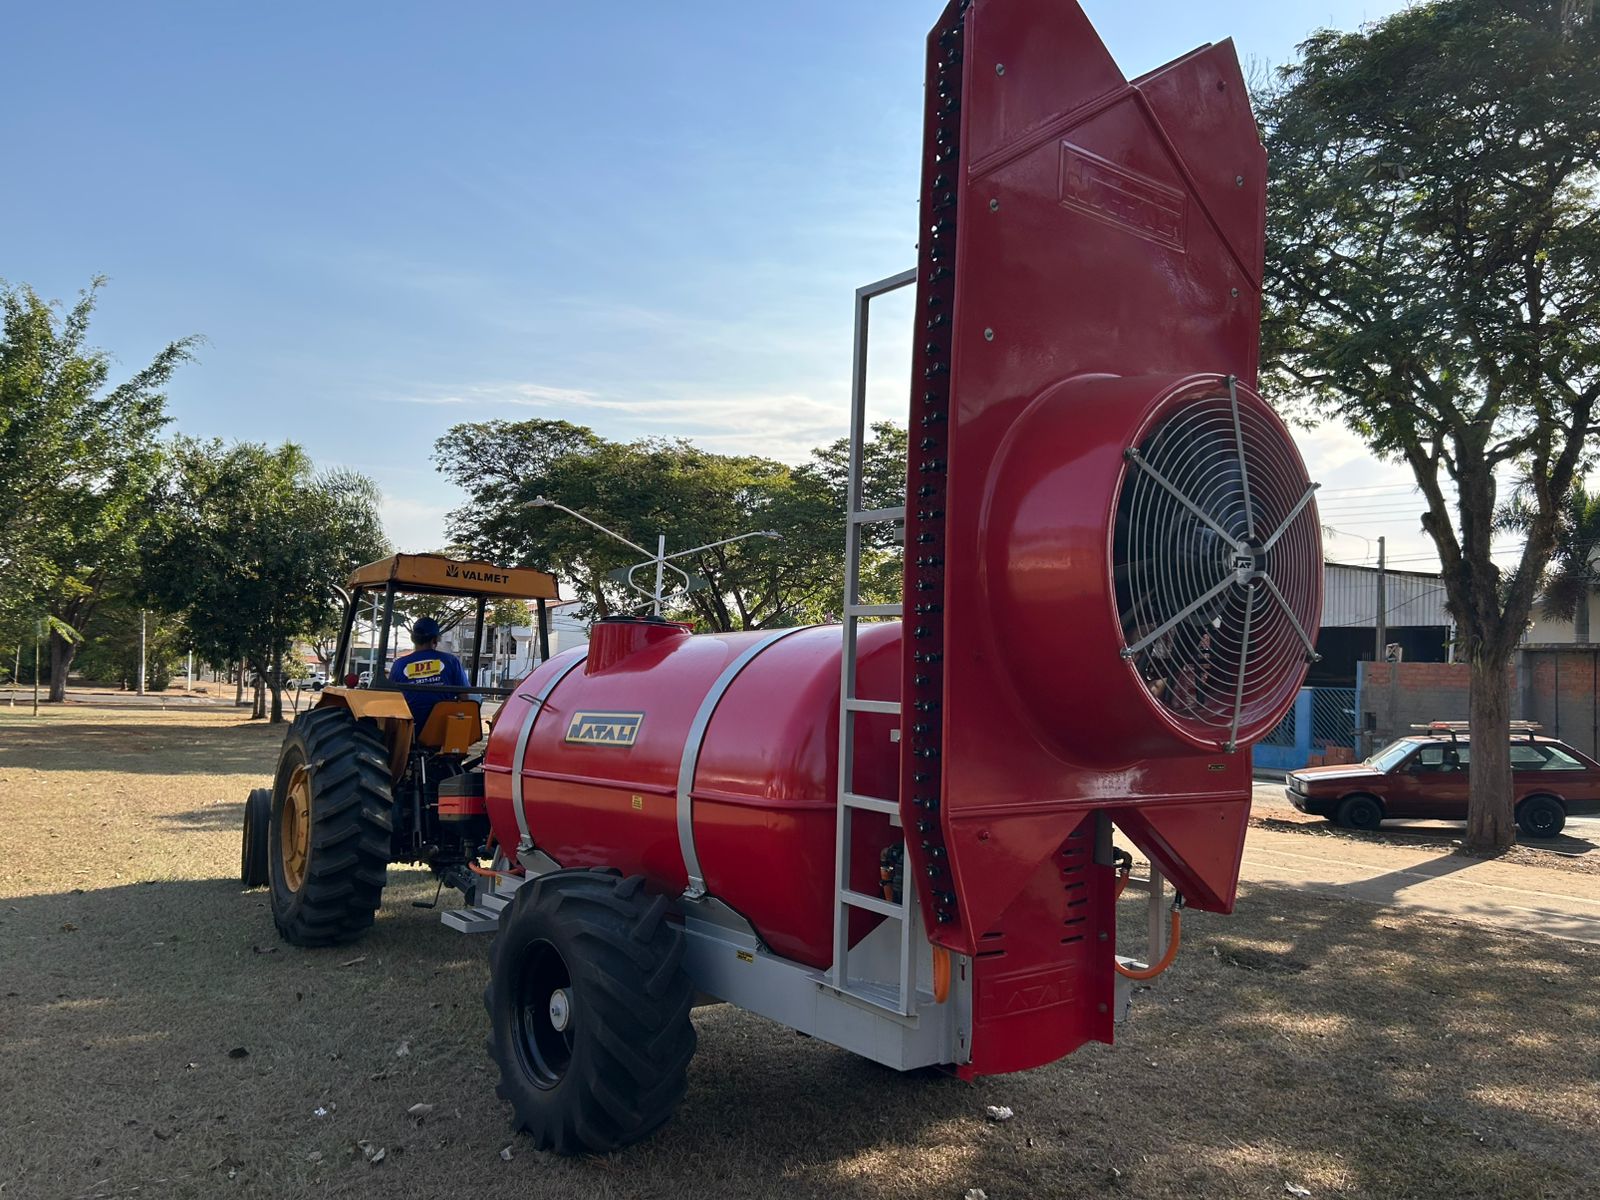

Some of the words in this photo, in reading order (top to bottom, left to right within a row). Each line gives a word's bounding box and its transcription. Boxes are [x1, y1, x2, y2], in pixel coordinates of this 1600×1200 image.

[462, 570, 509, 584] VALMET
[415, 661, 433, 672] DT
[568, 716, 640, 741] NATALI
